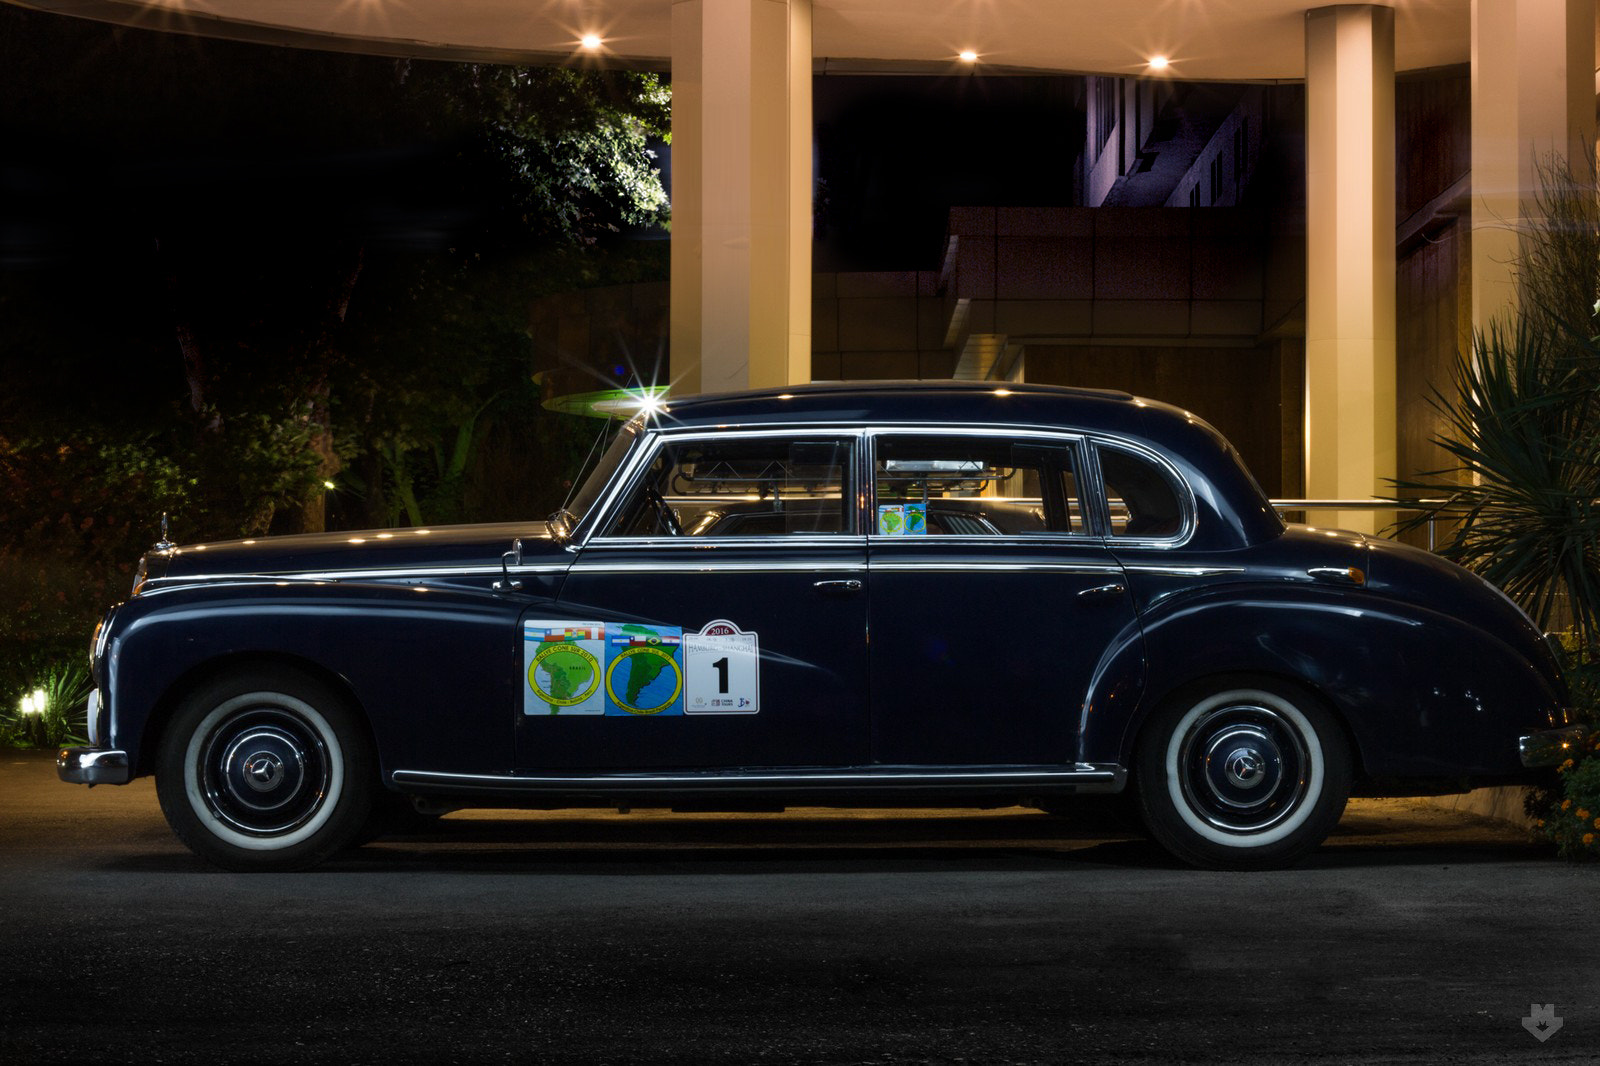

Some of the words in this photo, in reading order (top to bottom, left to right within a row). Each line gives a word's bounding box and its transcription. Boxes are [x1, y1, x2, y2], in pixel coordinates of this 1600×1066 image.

[711, 627, 729, 635] 2016
[581, 650, 593, 663] 2010
[712, 657, 728, 694] 1
